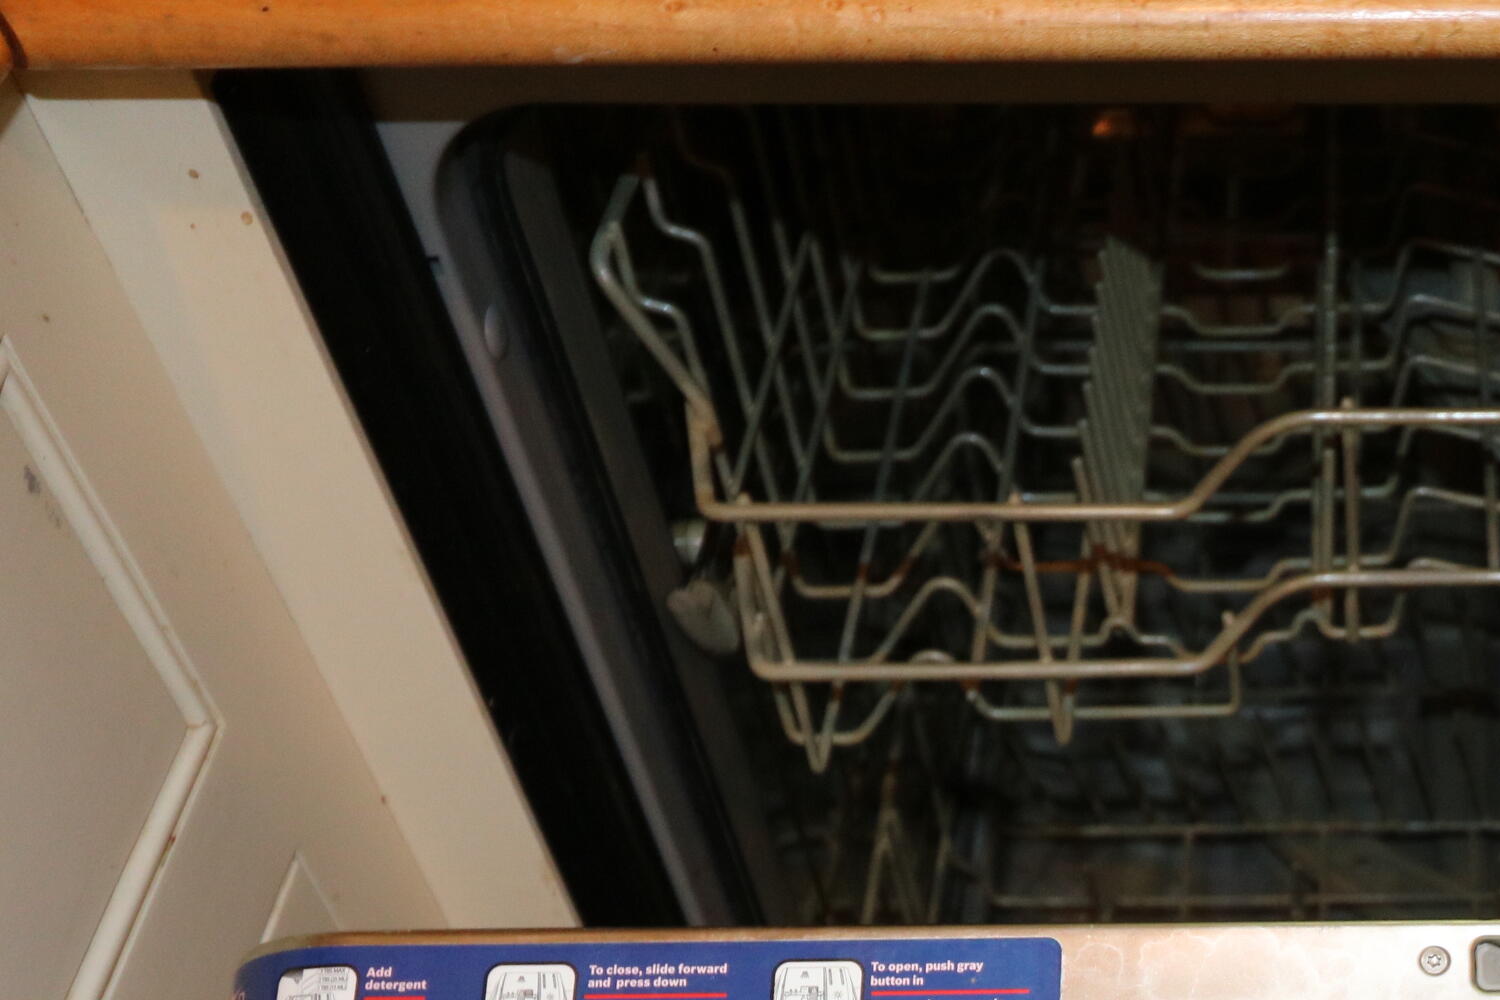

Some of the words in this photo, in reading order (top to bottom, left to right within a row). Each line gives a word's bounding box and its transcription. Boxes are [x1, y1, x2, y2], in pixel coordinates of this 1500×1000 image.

[366, 967, 392, 977] Add
[589, 965, 603, 975] To
[607, 964, 643, 976] close,
[646, 963, 676, 975] slide
[678, 963, 728, 975] forward
[871, 961, 885, 973] To
[888, 962, 922, 974] open,
[925, 960, 955, 973] push
[956, 961, 984, 973] gray
[365, 979, 427, 993] detergent
[588, 978, 611, 988] and
[616, 978, 651, 990] press
[653, 977, 687, 988] down
[870, 975, 910, 986] button
[912, 975, 924, 986] in
